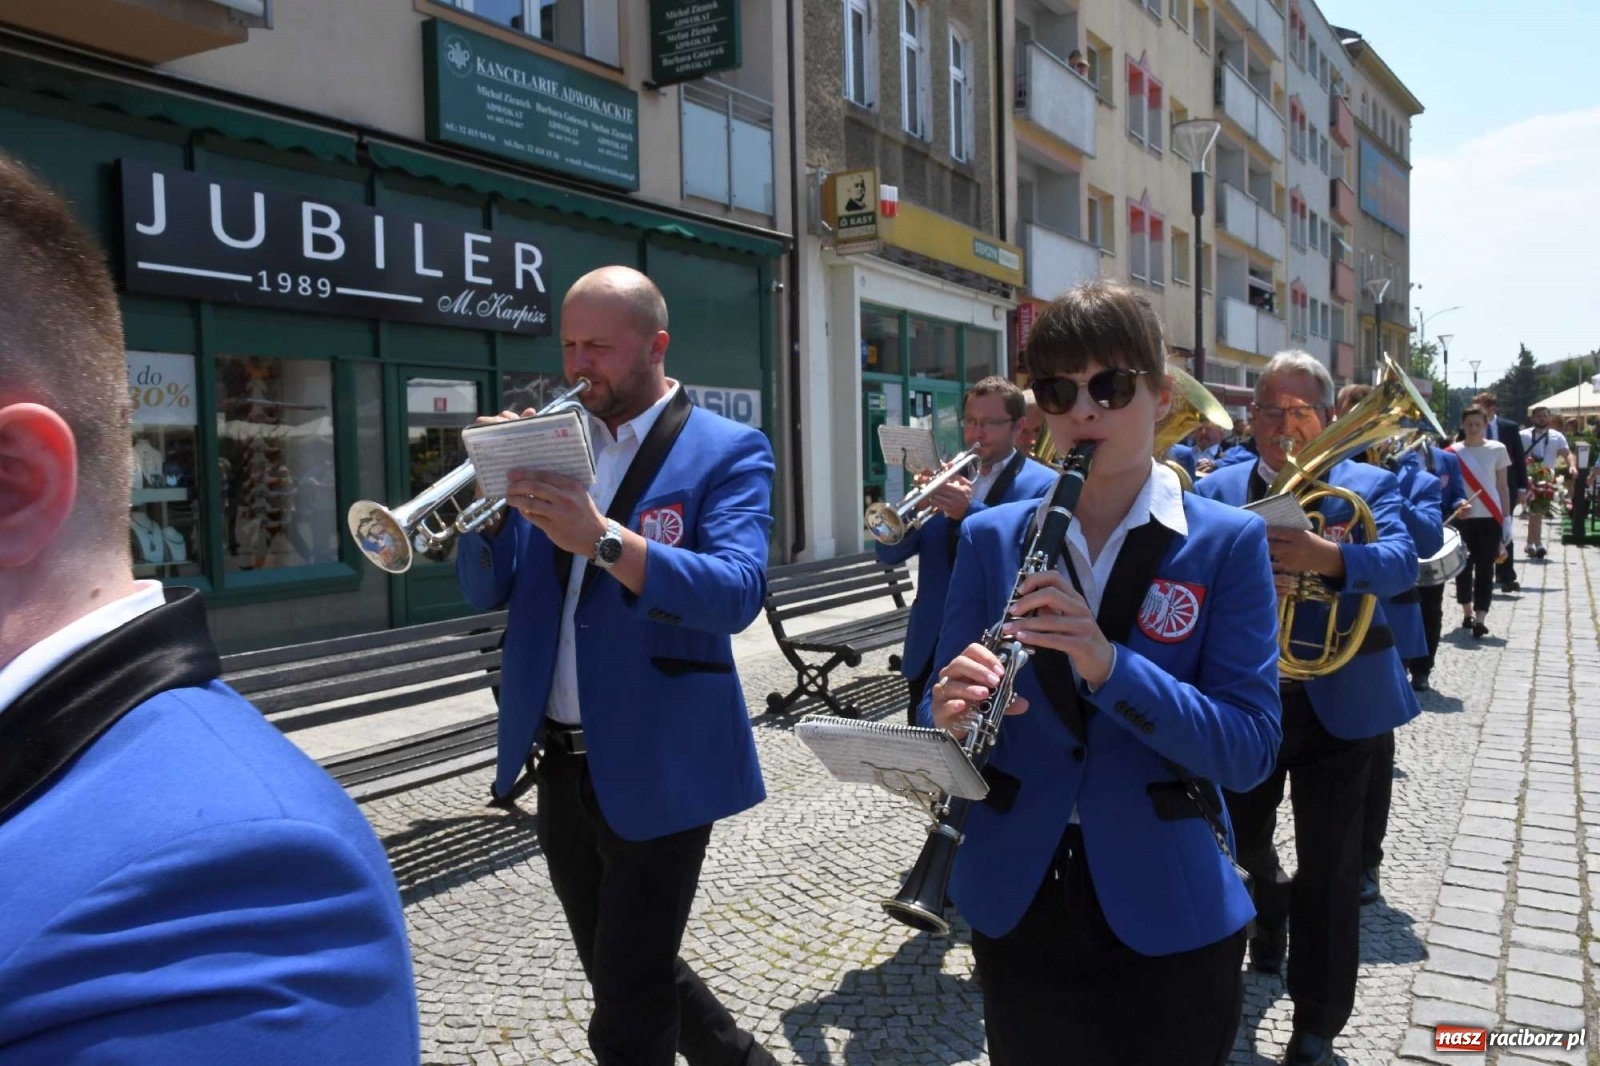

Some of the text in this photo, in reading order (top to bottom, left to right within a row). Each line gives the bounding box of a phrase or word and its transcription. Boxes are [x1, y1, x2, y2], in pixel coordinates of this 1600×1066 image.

[674, 12, 711, 27] ADWOKAT
[675, 35, 711, 50] ADWOKAT
[675, 59, 712, 73] ADWOKAT
[476, 56, 559, 97] KANCELARIE
[561, 86, 634, 122] ADWOKACKIE
[486, 101, 525, 120] ADWOKAT
[849, 215, 873, 225] KASY
[136, 172, 546, 293] JUBILER
[258, 270, 331, 298] 1989
[437, 288, 547, 329] M. Karpisz
[137, 365, 162, 386] do
[687, 389, 752, 423] ASIO
